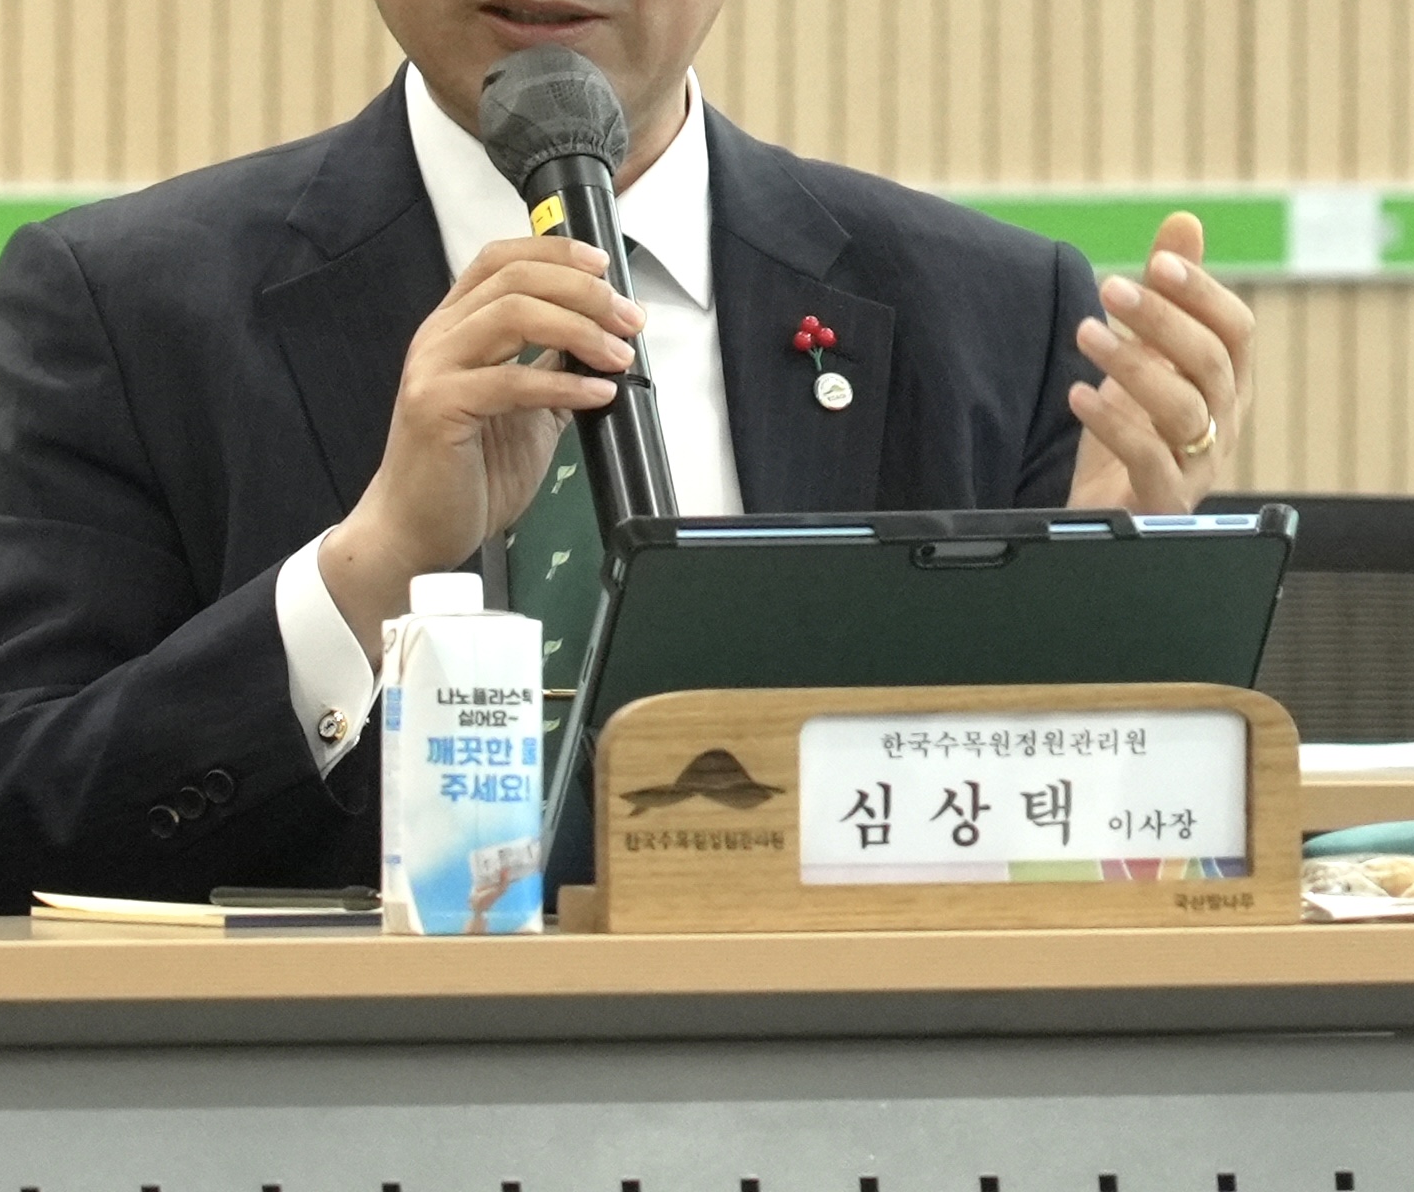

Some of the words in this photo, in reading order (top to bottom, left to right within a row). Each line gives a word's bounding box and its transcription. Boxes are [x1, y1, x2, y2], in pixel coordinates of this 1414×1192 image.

[437, 687, 533, 706] 나노플라스틱
[427, 736, 513, 766] 깨끗한
[881, 728, 1147, 759] 한국수목원정원관리원
[441, 773, 530, 802] 주세요!
[1109, 808, 1197, 840] 이사장
